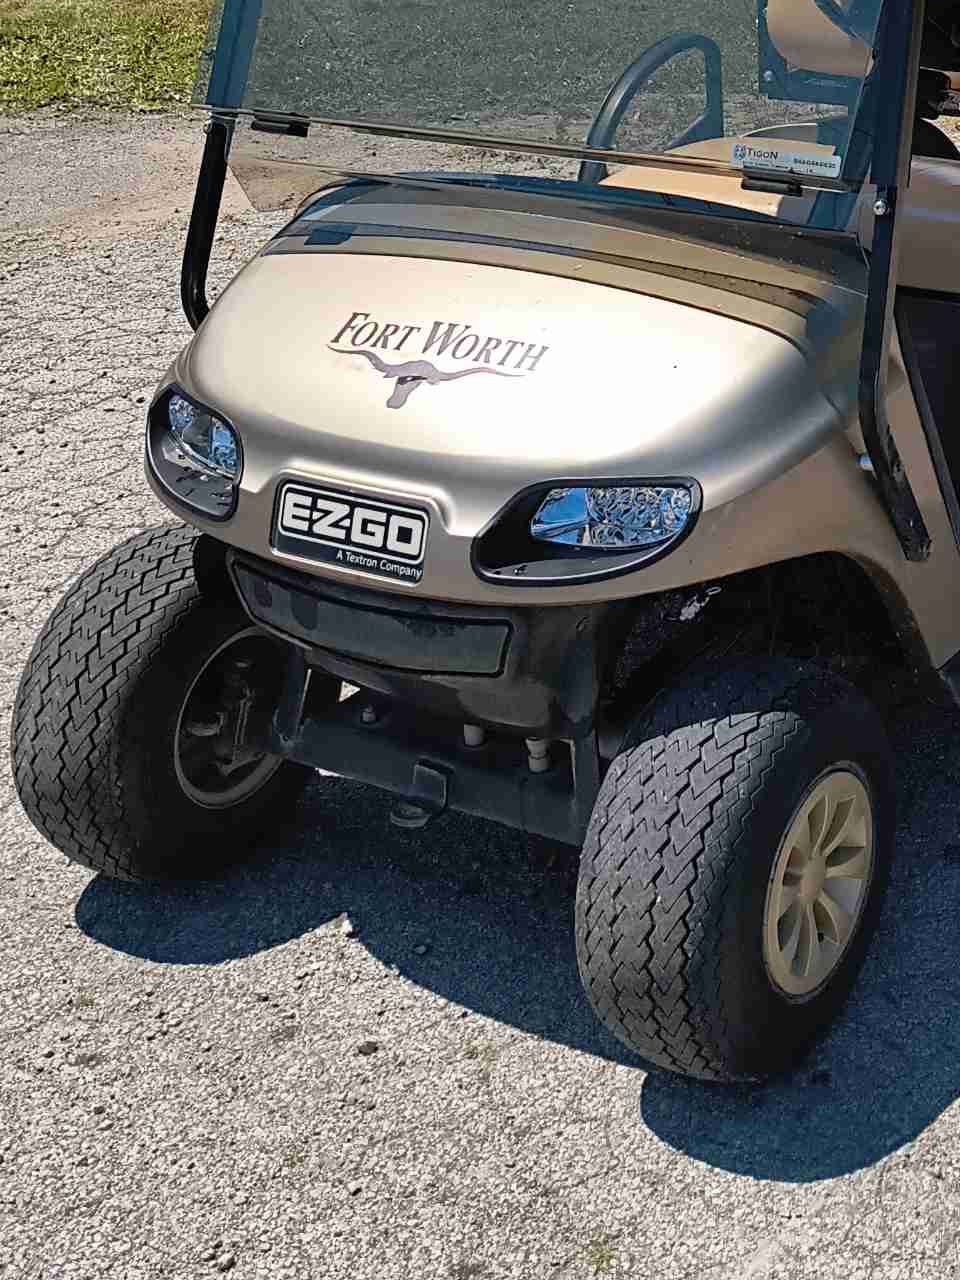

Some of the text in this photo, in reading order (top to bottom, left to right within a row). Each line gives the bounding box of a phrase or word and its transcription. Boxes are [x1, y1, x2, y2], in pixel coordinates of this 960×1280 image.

[747, 147, 778, 160] TIGON
[330, 312, 549, 371] FORT WORTH
[336, 550, 423, 581] A Textron Company
